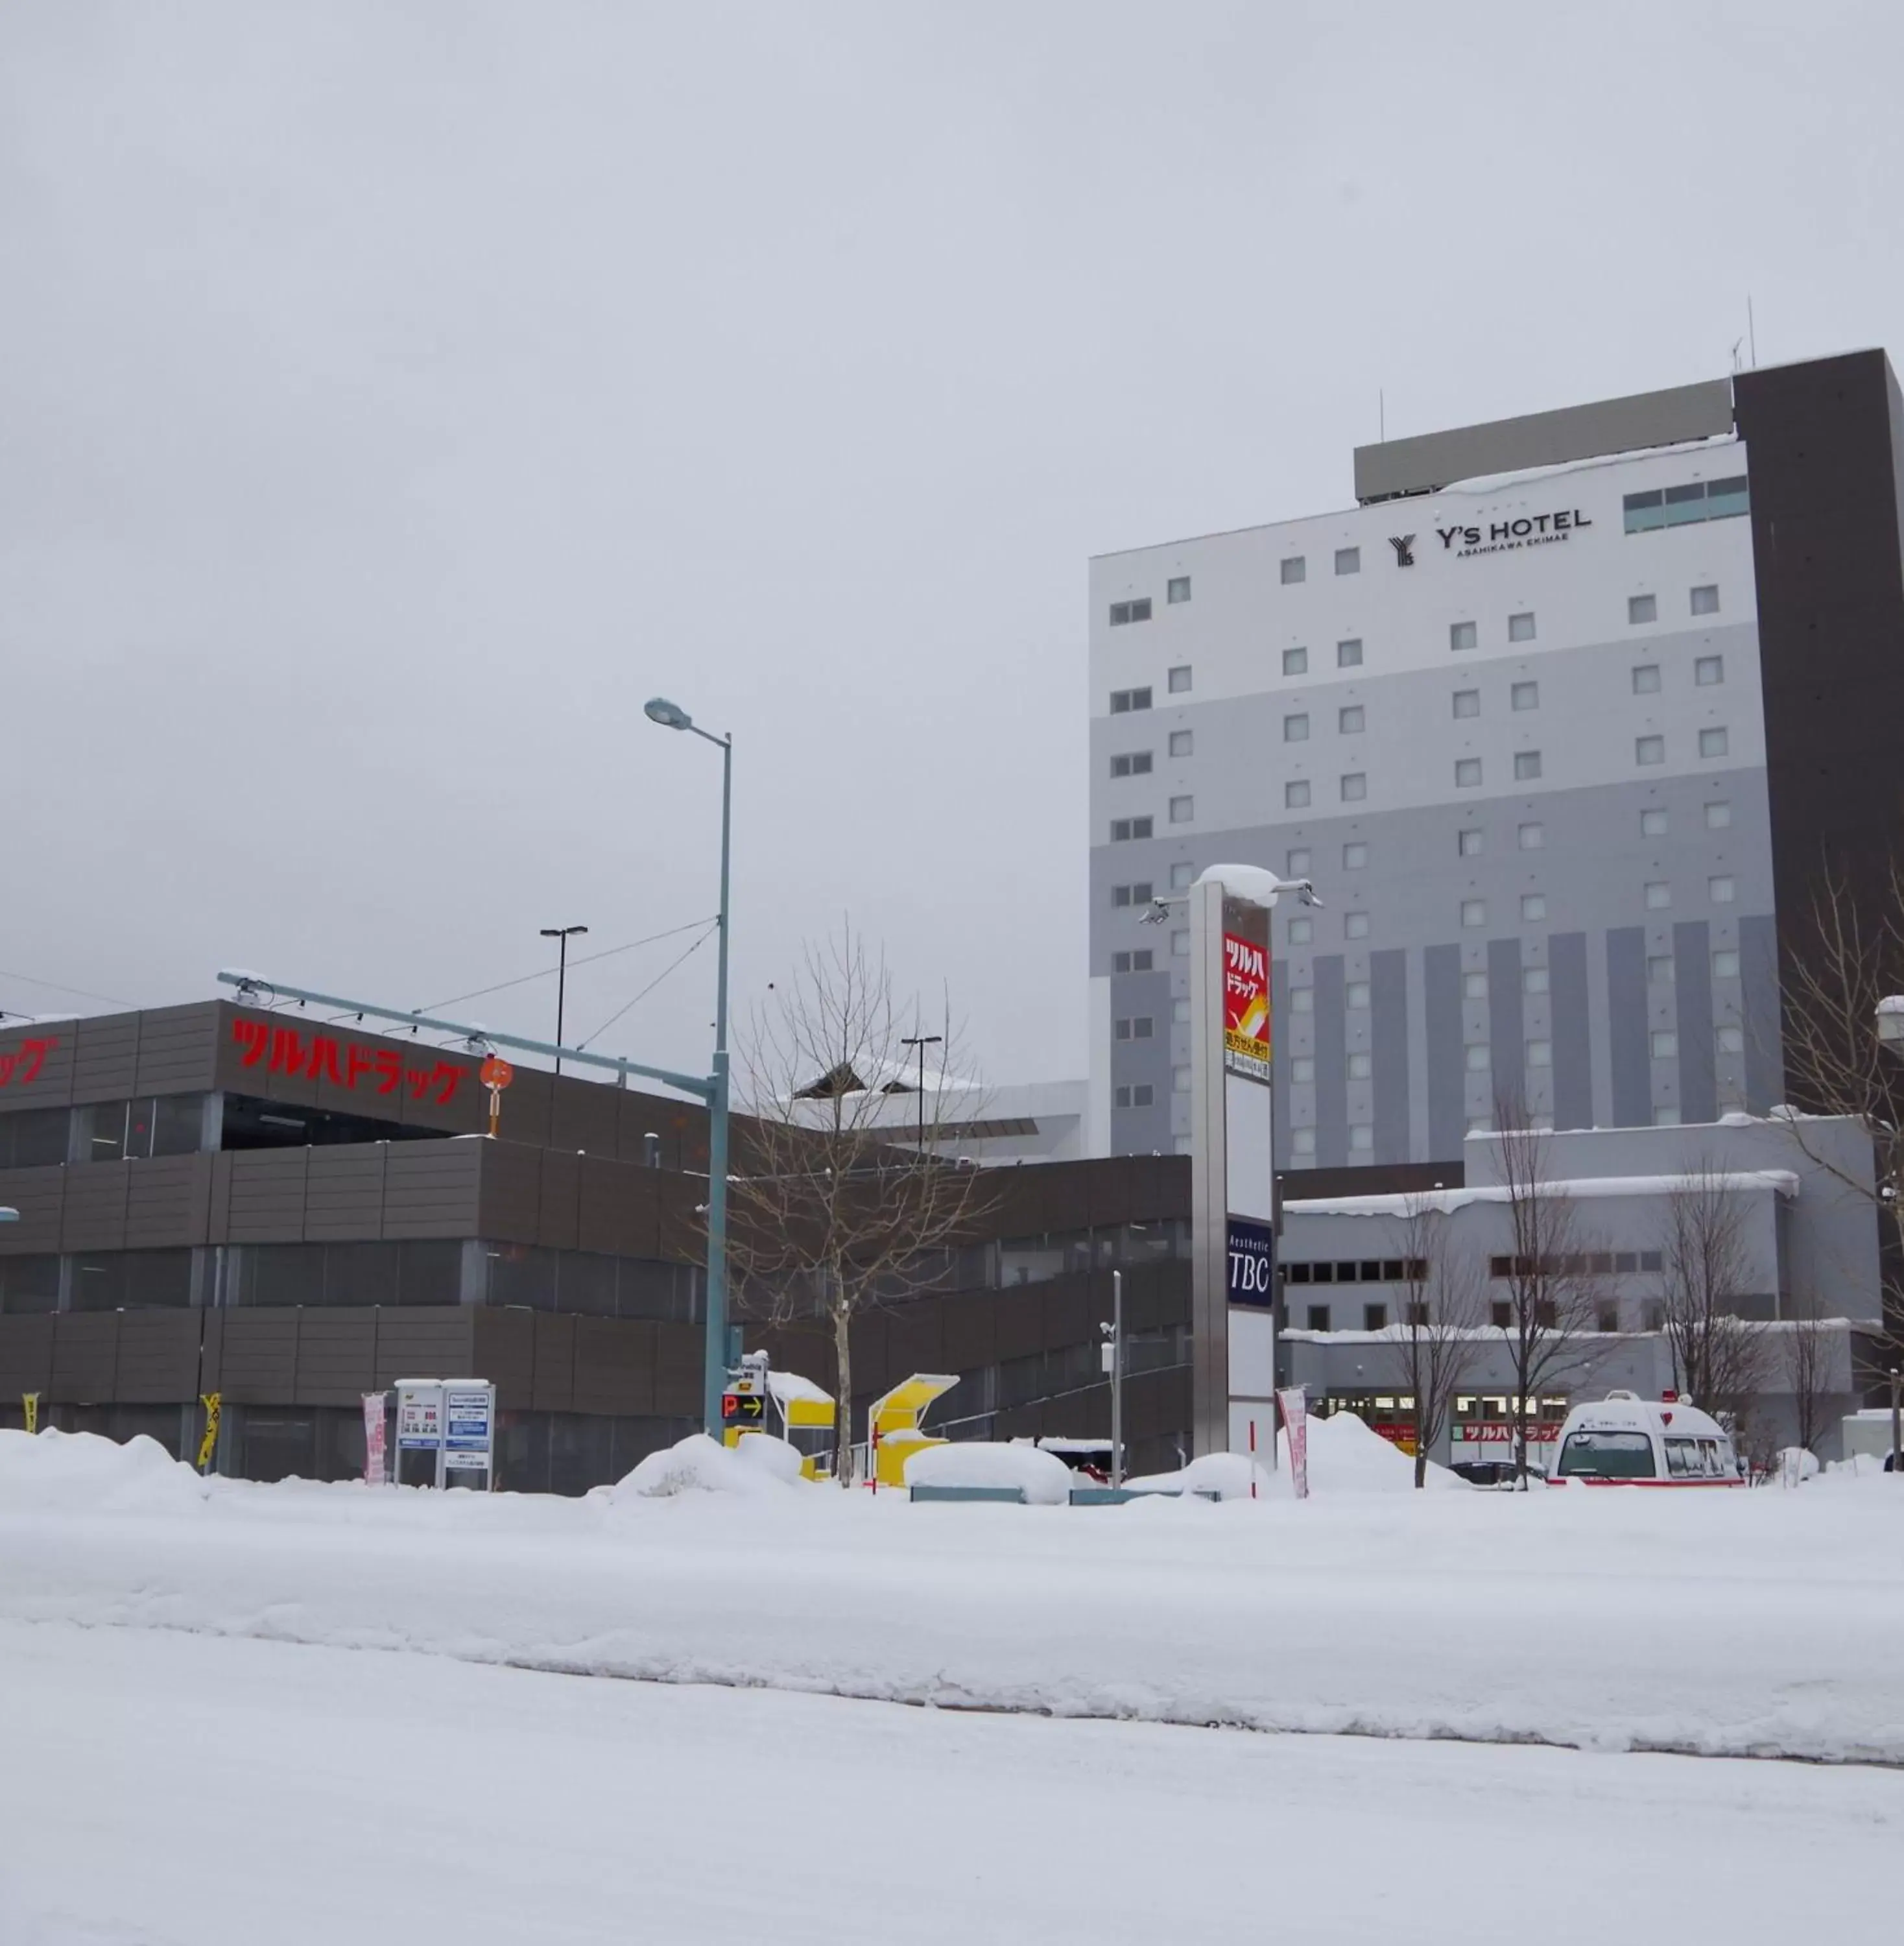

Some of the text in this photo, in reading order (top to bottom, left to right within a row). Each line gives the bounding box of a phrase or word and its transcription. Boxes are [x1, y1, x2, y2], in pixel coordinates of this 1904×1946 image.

[1490, 509, 1592, 540] HOTEL
[1457, 533, 1569, 558] ASAHIKAWA EKIMAE
[1226, 939, 1265, 980] ツルハ
[1227, 970, 1259, 1001] ドラッグ
[232, 1019, 471, 1105] ツルハドラッグ
[1230, 1234, 1269, 1253] Aesthetic
[1229, 1251, 1269, 1293] TBC
[724, 1395, 737, 1418] P
